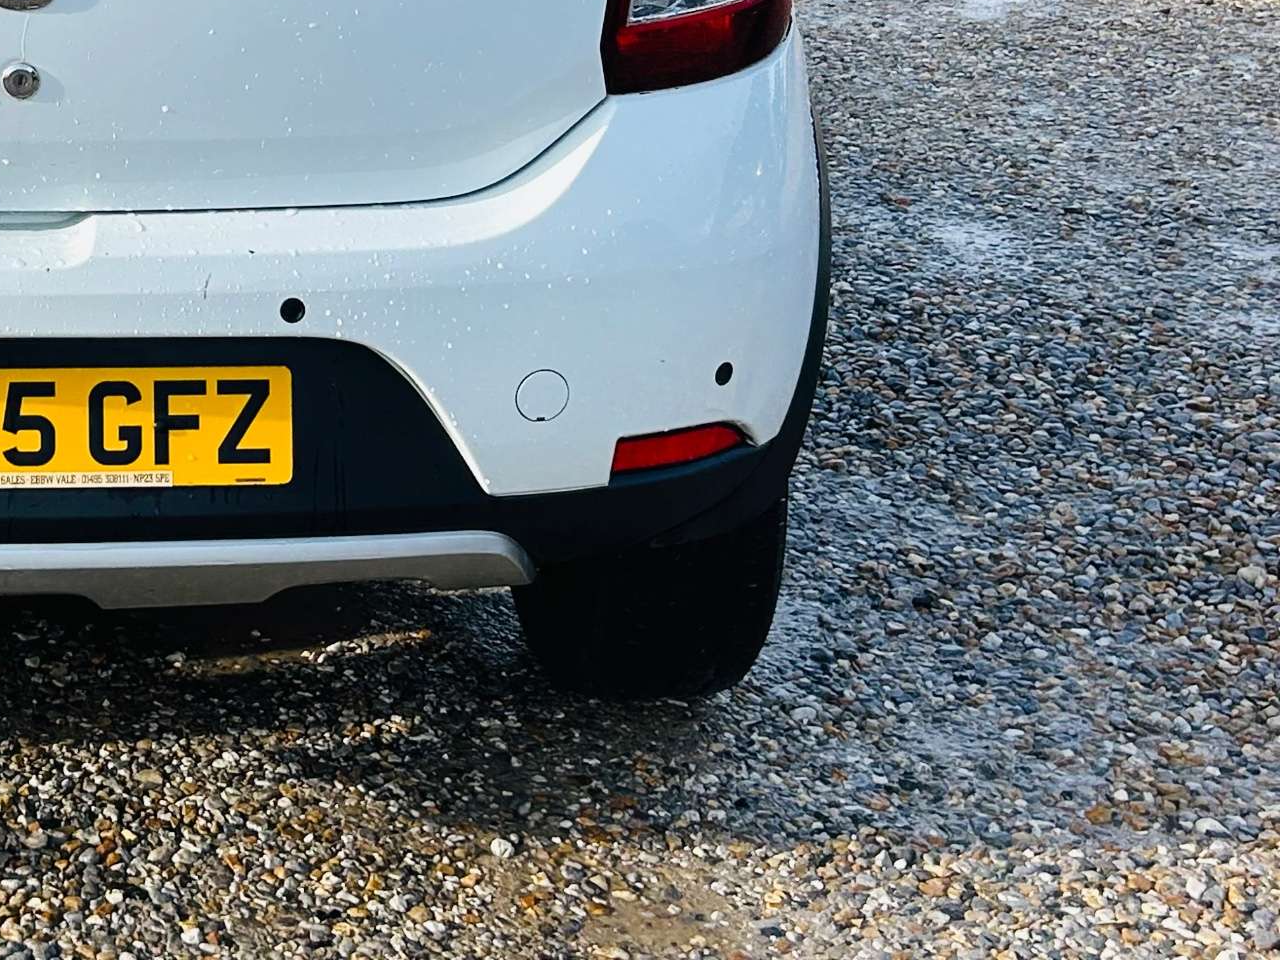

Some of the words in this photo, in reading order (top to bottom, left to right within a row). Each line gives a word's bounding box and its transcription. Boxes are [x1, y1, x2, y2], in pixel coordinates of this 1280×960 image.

[88, 379, 271, 467] GFZ
[1, 474, 25, 485] SALES
[30, 475, 53, 485] EBBW
[56, 474, 76, 484] VALE
